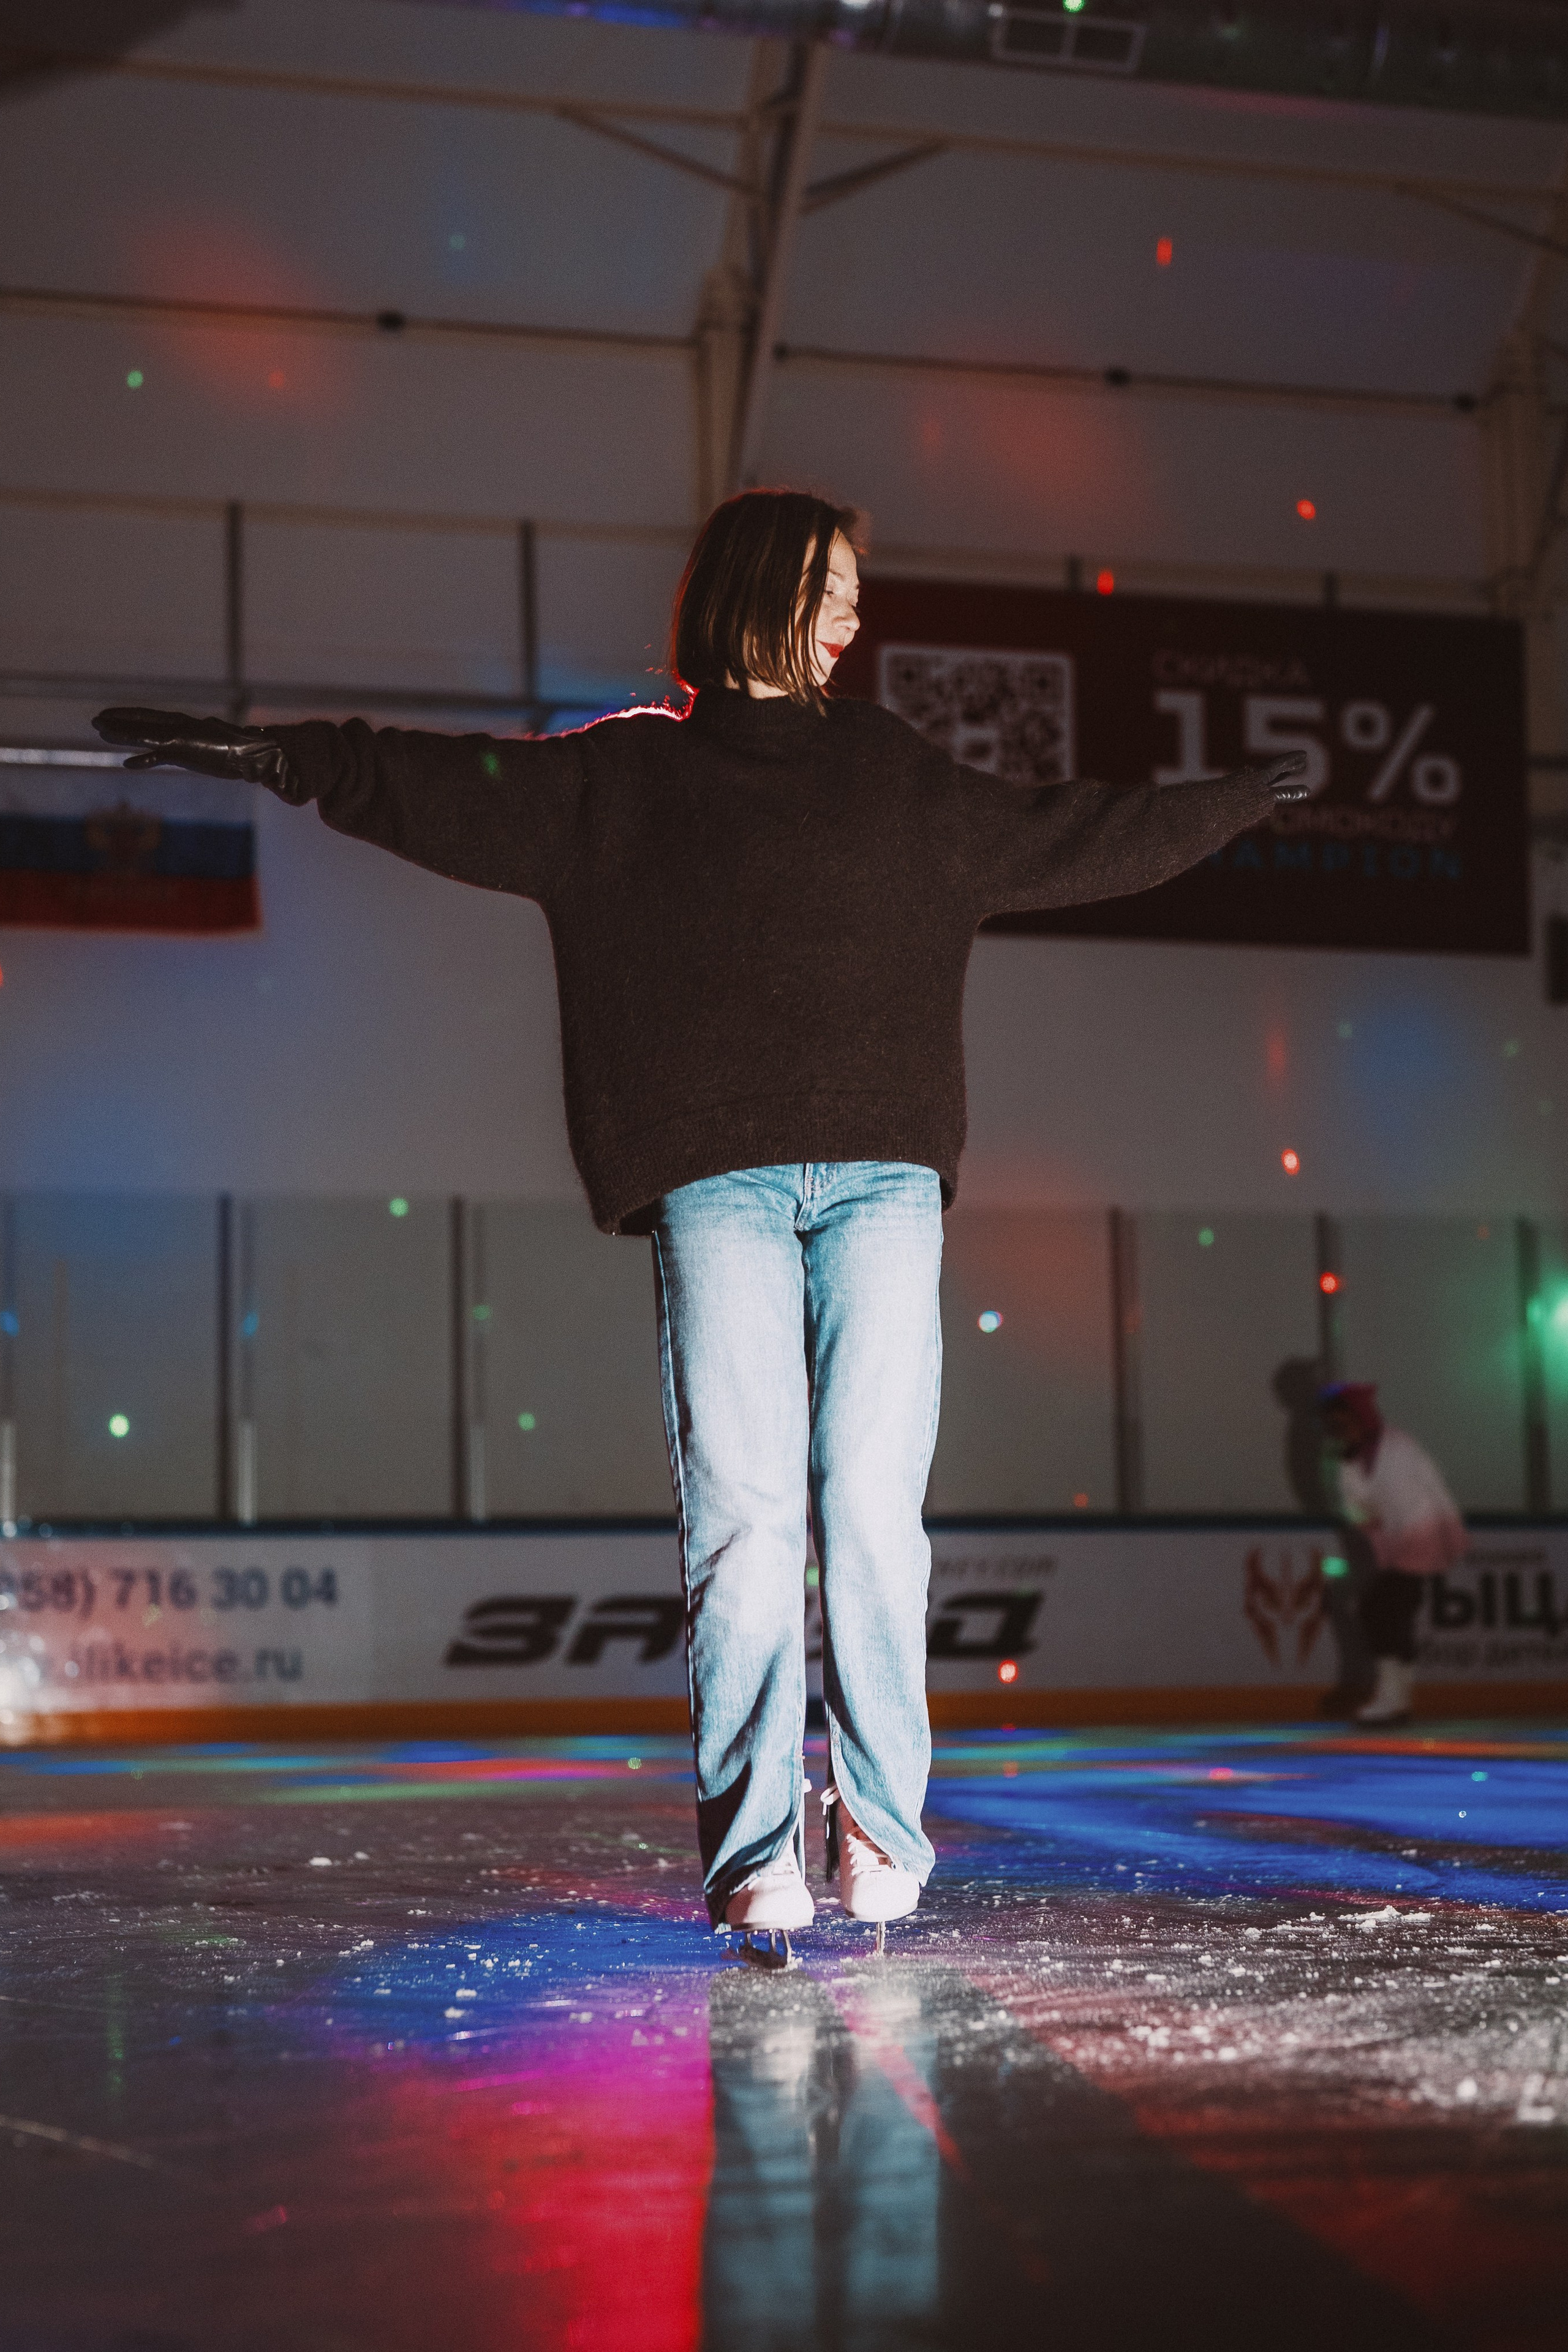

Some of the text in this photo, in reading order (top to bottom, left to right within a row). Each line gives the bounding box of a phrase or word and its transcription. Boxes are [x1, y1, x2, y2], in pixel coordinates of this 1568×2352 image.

[1152, 688, 1464, 805] 15%
[1270, 804, 1458, 846] ОМОКОДУ
[1214, 841, 1461, 879] AMPION
[111, 1567, 198, 1610] 716
[212, 1567, 270, 1611] 30
[281, 1567, 338, 1610] 04
[1426, 1572, 1568, 1636] ЫЦ
[446, 1591, 1042, 1665] ЗАД
